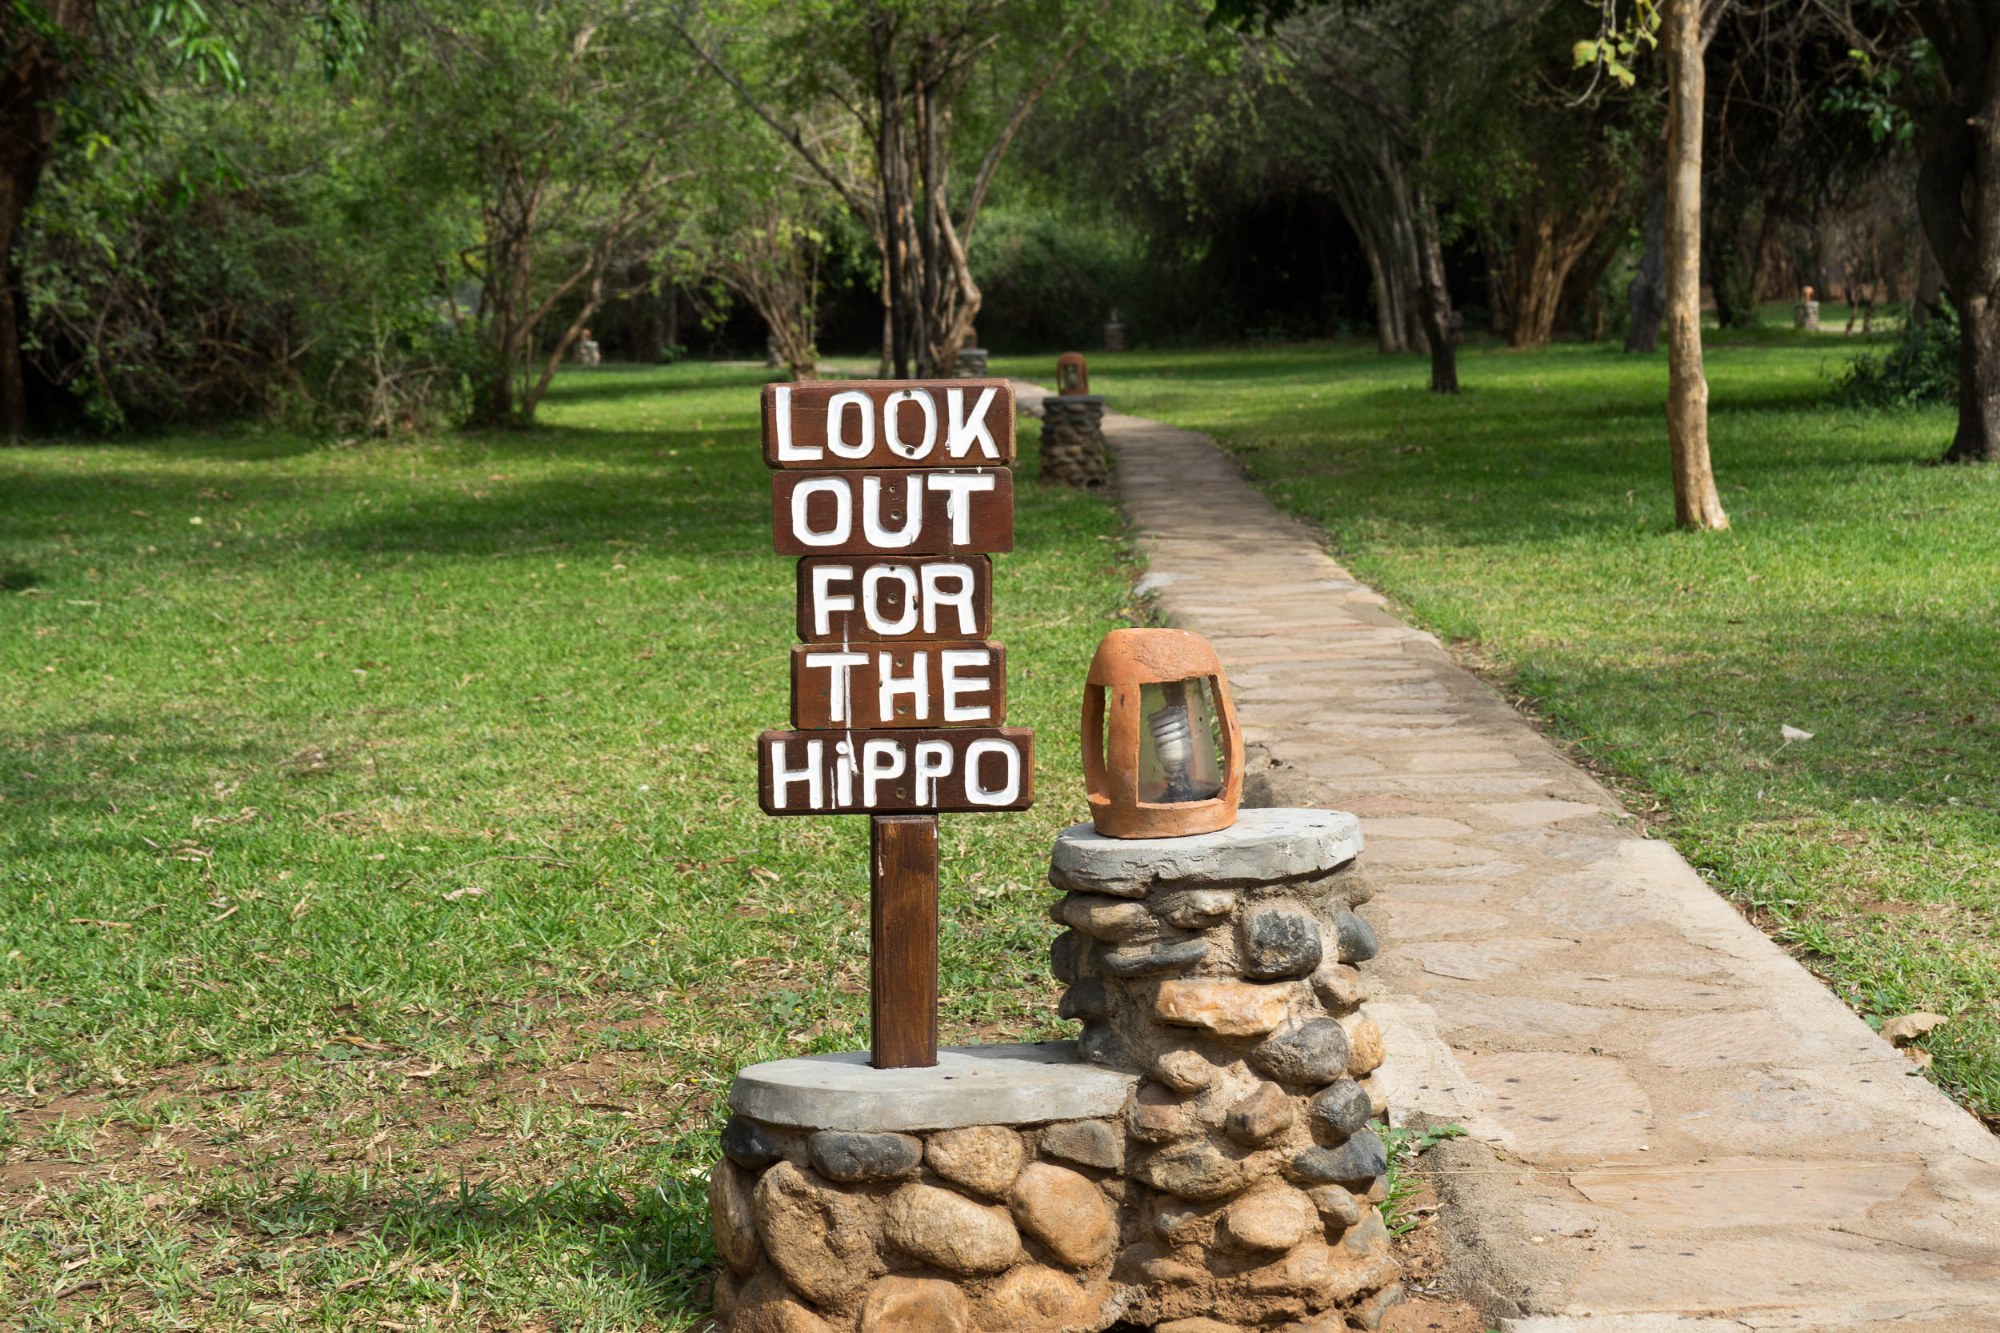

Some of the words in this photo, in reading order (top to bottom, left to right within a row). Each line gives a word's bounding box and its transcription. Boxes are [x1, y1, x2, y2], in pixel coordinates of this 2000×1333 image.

[775, 386, 1000, 461] LOOK
[791, 473, 995, 548] OUT
[812, 564, 978, 636] FOR
[805, 649, 991, 723] THE
